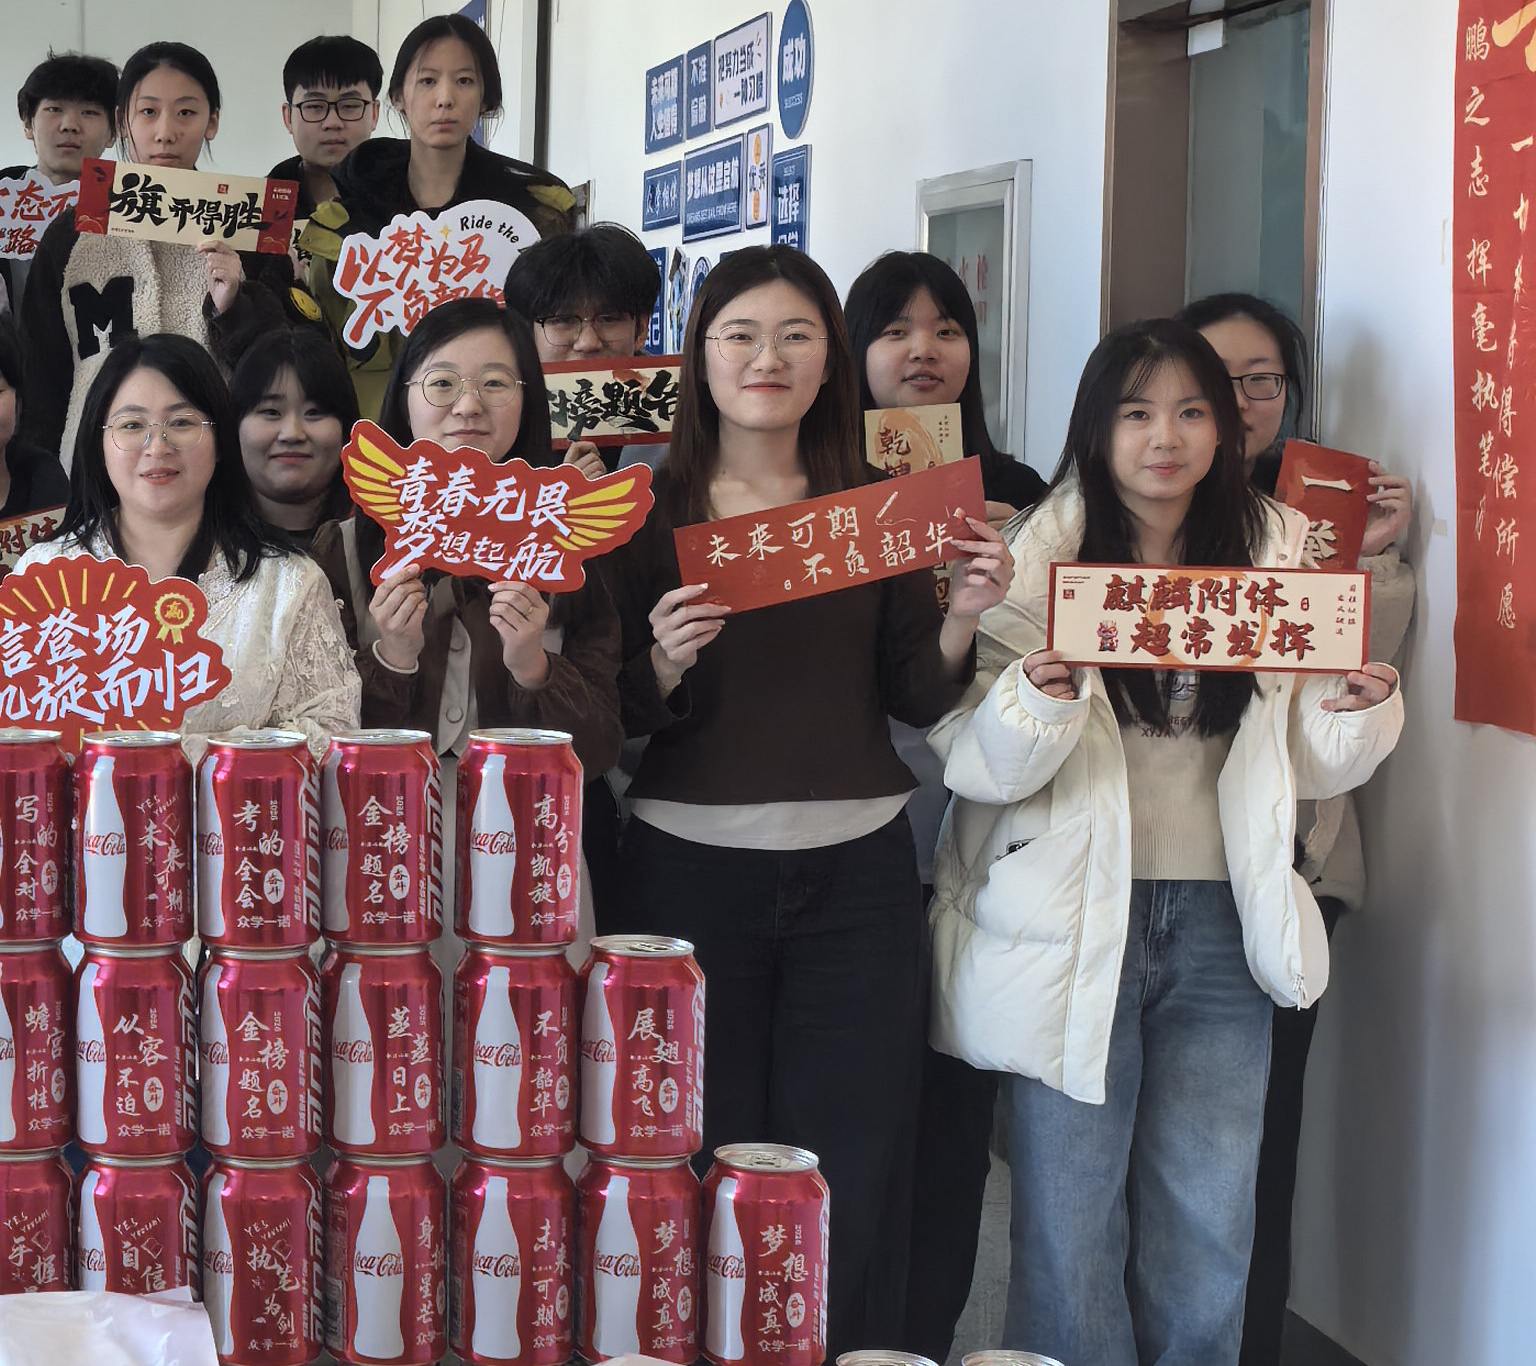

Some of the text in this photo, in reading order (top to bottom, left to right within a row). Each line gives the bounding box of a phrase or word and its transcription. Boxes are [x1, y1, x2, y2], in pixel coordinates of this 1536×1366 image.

[109, 173, 272, 238] 旗开得胜
[460, 215, 520, 245] Ride the
[339, 223, 491, 293] 以梦为马
[390, 455, 571, 538] 青春无畏
[380, 508, 566, 582] 梦想起航
[802, 521, 953, 585] 不负韶华
[1102, 574, 1289, 616] 麒麟附体
[1131, 615, 1315, 661] 超常发挥
[233, 800, 285, 910] 考的全会
[358, 795, 412, 904] 金榜题名
[237, 914, 291, 928] 众学一诺
[362, 911, 416, 925] 众学一诺
[113, 1015, 168, 1116] 从容不迫
[235, 1011, 290, 1119] 金榜题名
[387, 1006, 432, 1113] 蒸蒸日上
[628, 1007, 684, 1117] 展翅高飞
[118, 1122, 170, 1137] 众学一诺
[241, 1126, 295, 1139] 众学一诺
[246, 1242, 299, 1335] 执笔为剑
[759, 1225, 808, 1335] 梦想成真
